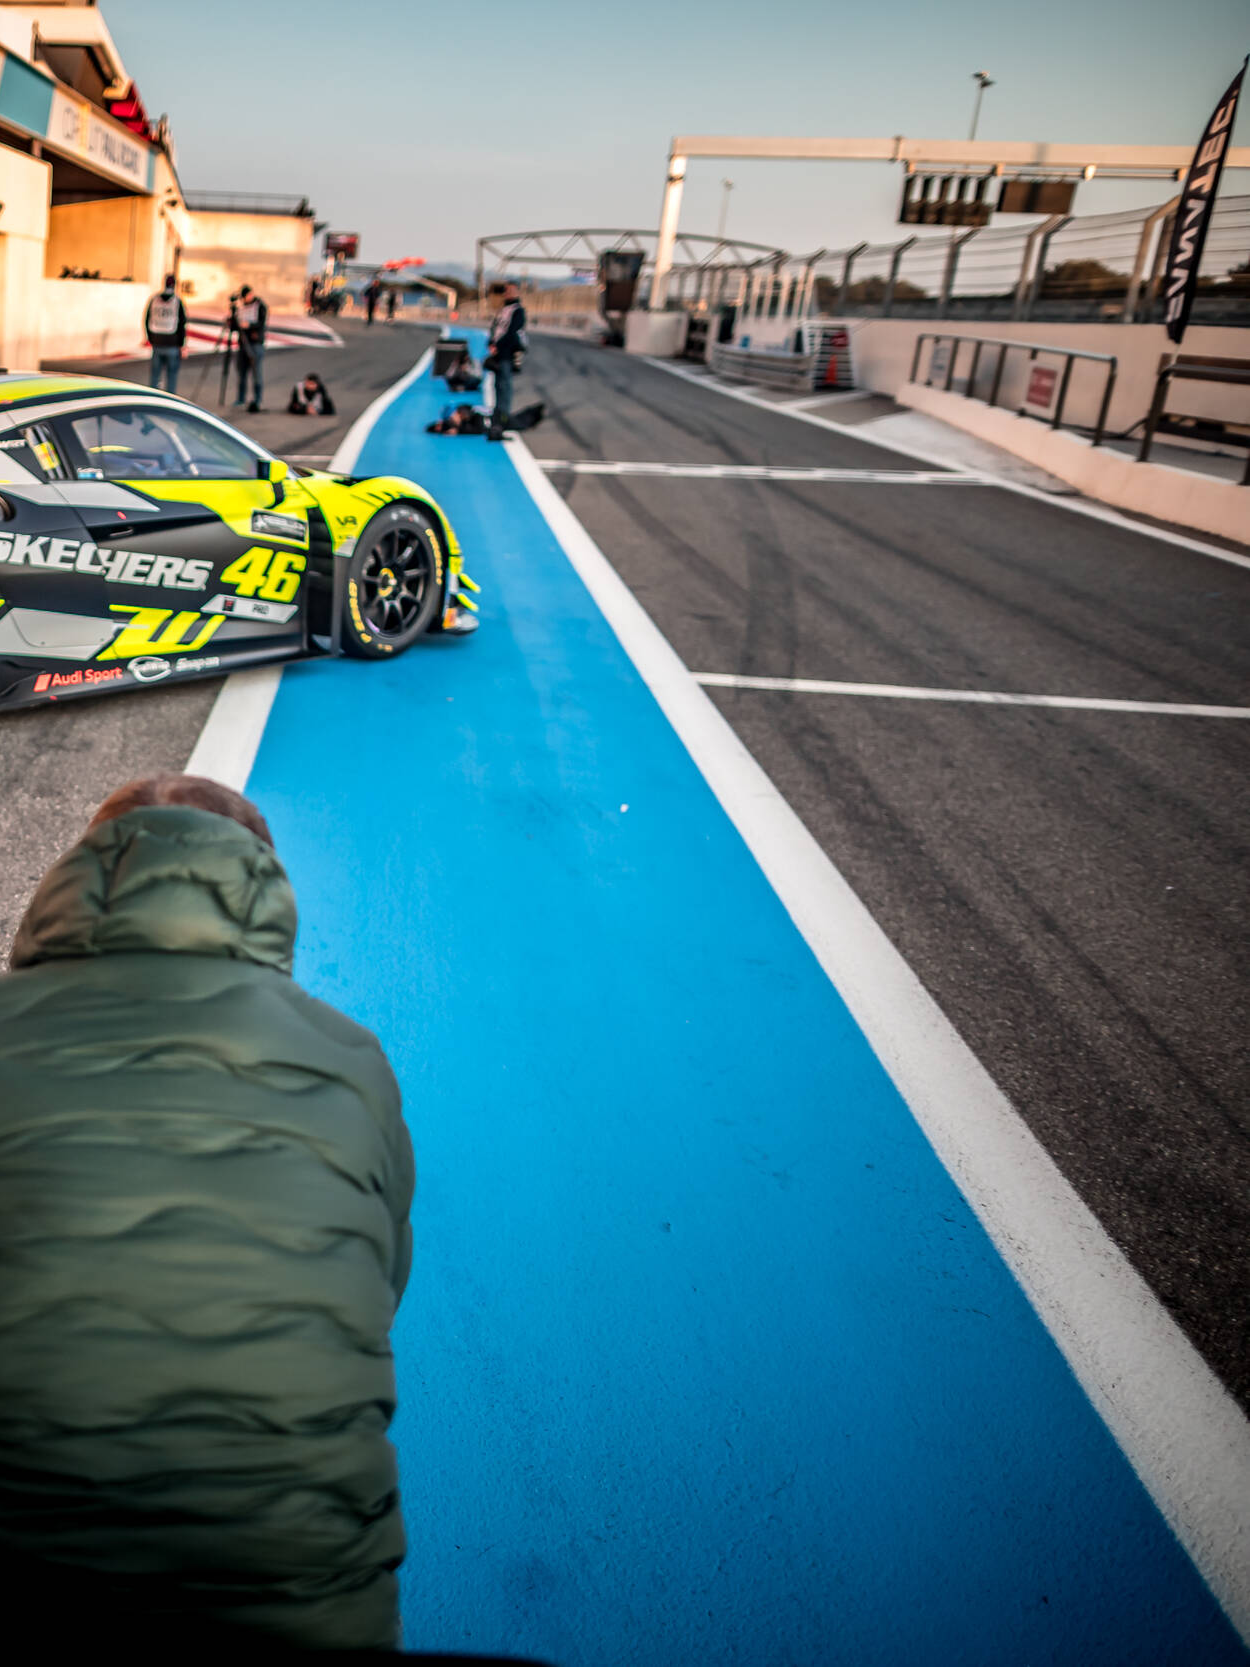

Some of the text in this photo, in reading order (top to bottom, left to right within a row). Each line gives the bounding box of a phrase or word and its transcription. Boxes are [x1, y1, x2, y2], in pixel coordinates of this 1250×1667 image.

[220, 546, 307, 603] 46
[51, 672, 83, 687] Audi
[84, 666, 123, 685] Sport
